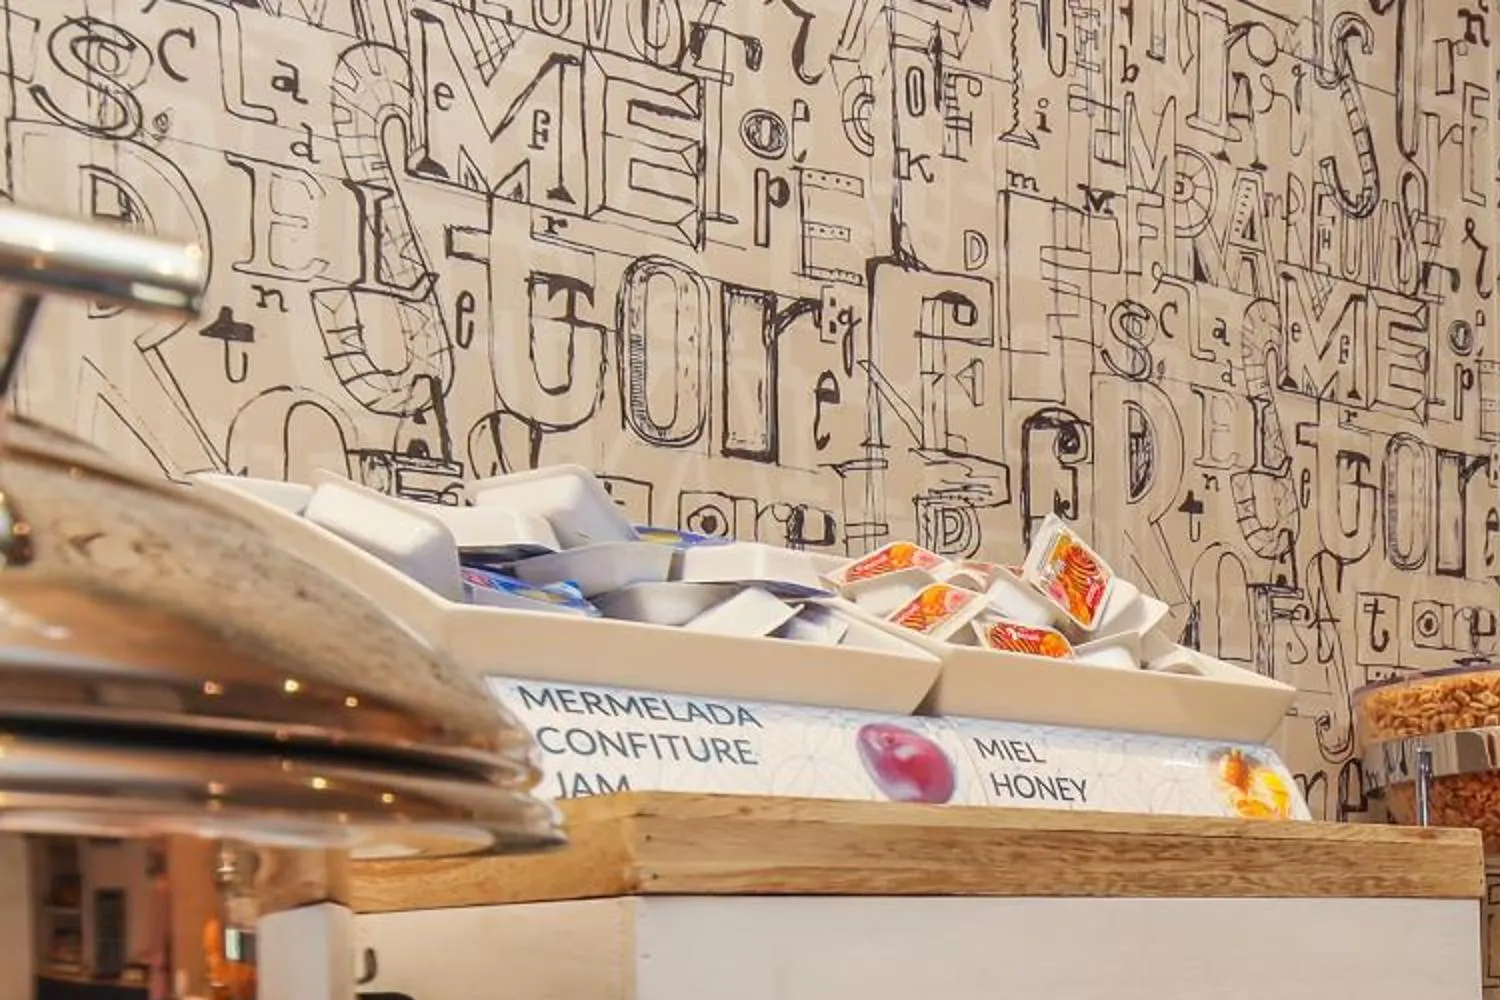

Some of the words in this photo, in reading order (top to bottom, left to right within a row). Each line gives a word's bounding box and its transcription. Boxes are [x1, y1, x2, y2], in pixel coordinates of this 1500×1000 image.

[516, 685, 764, 729] MERMELADA
[536, 726, 760, 766] CONFITURE
[973, 737, 1047, 763] MIEL
[553, 771, 633, 799] JAM
[989, 772, 1088, 803] HONEY
